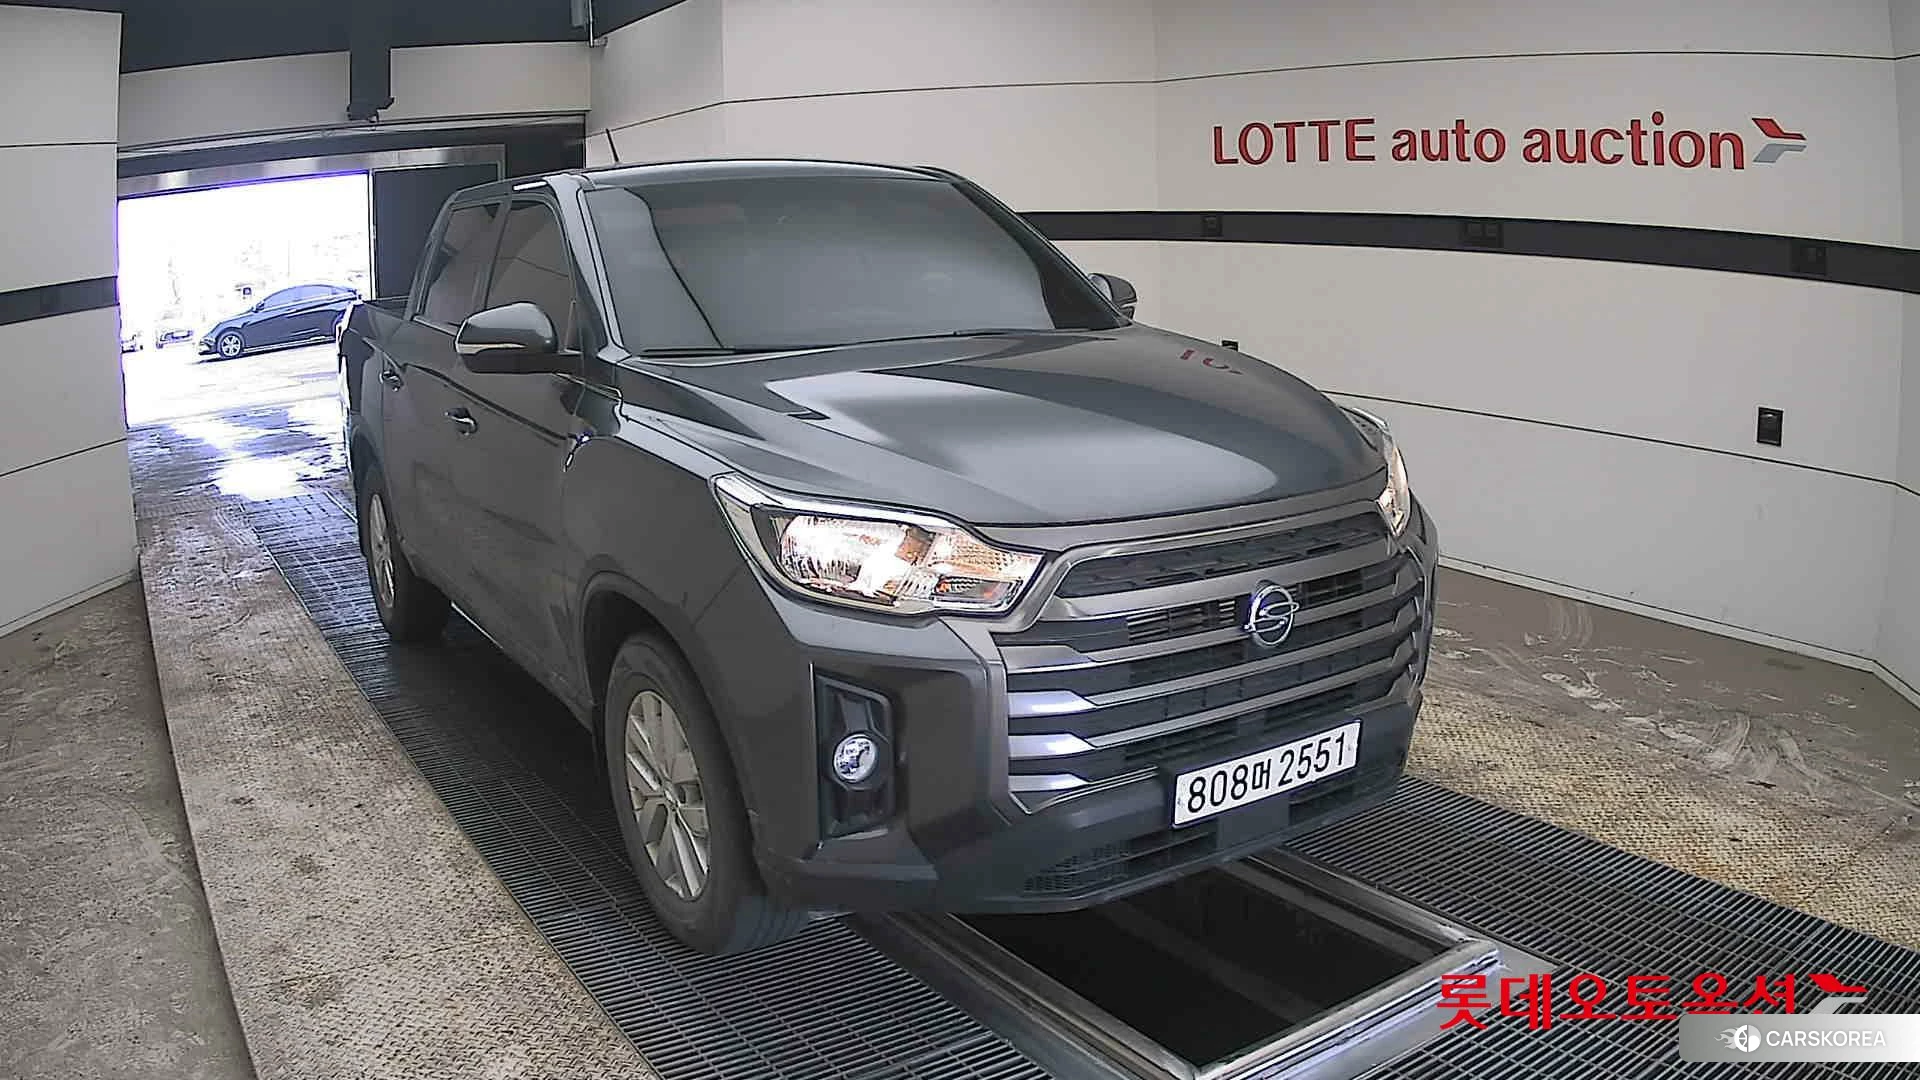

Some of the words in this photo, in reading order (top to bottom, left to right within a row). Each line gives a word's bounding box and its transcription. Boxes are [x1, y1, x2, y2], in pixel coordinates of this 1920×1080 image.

[1213, 118, 1375, 165] LOTTE
[1391, 118, 1507, 163] auto
[1522, 111, 1745, 170] auction
[1187, 758, 1272, 813] 808머
[1278, 732, 1345, 787] 2551
